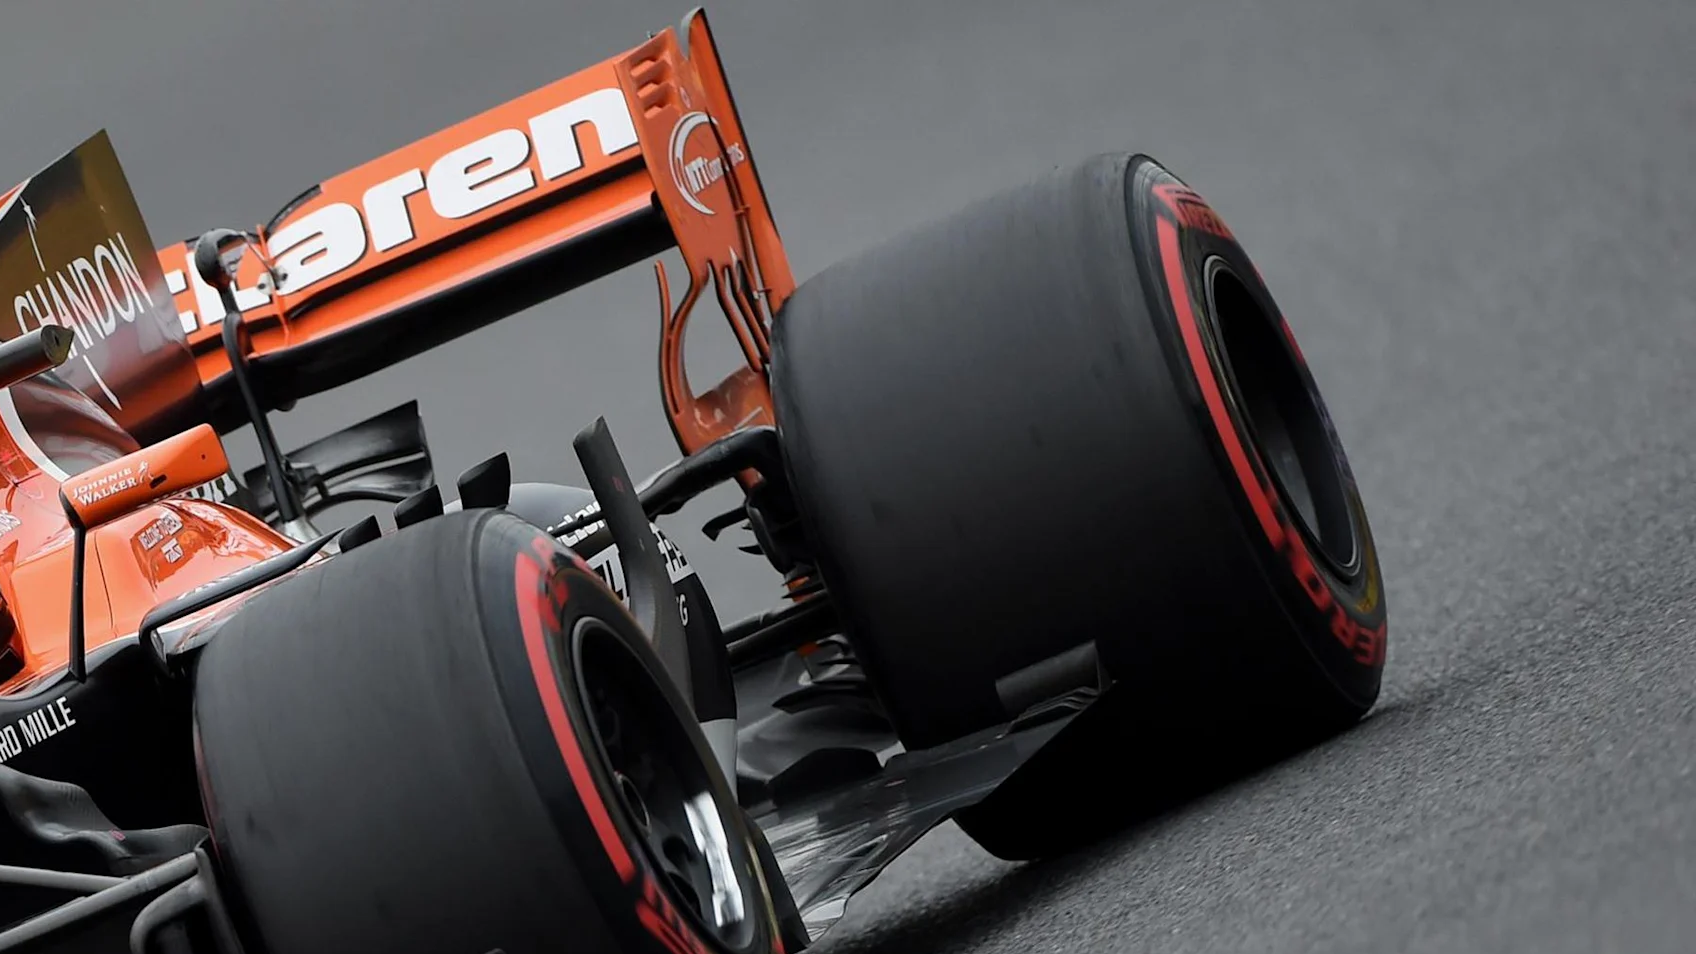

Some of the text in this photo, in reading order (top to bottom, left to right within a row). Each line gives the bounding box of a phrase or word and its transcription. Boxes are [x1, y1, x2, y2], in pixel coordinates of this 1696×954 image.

[72, 466, 133, 499] JOHNNIE
[77, 477, 138, 506] WALKER
[18, 696, 76, 748] MILLE
